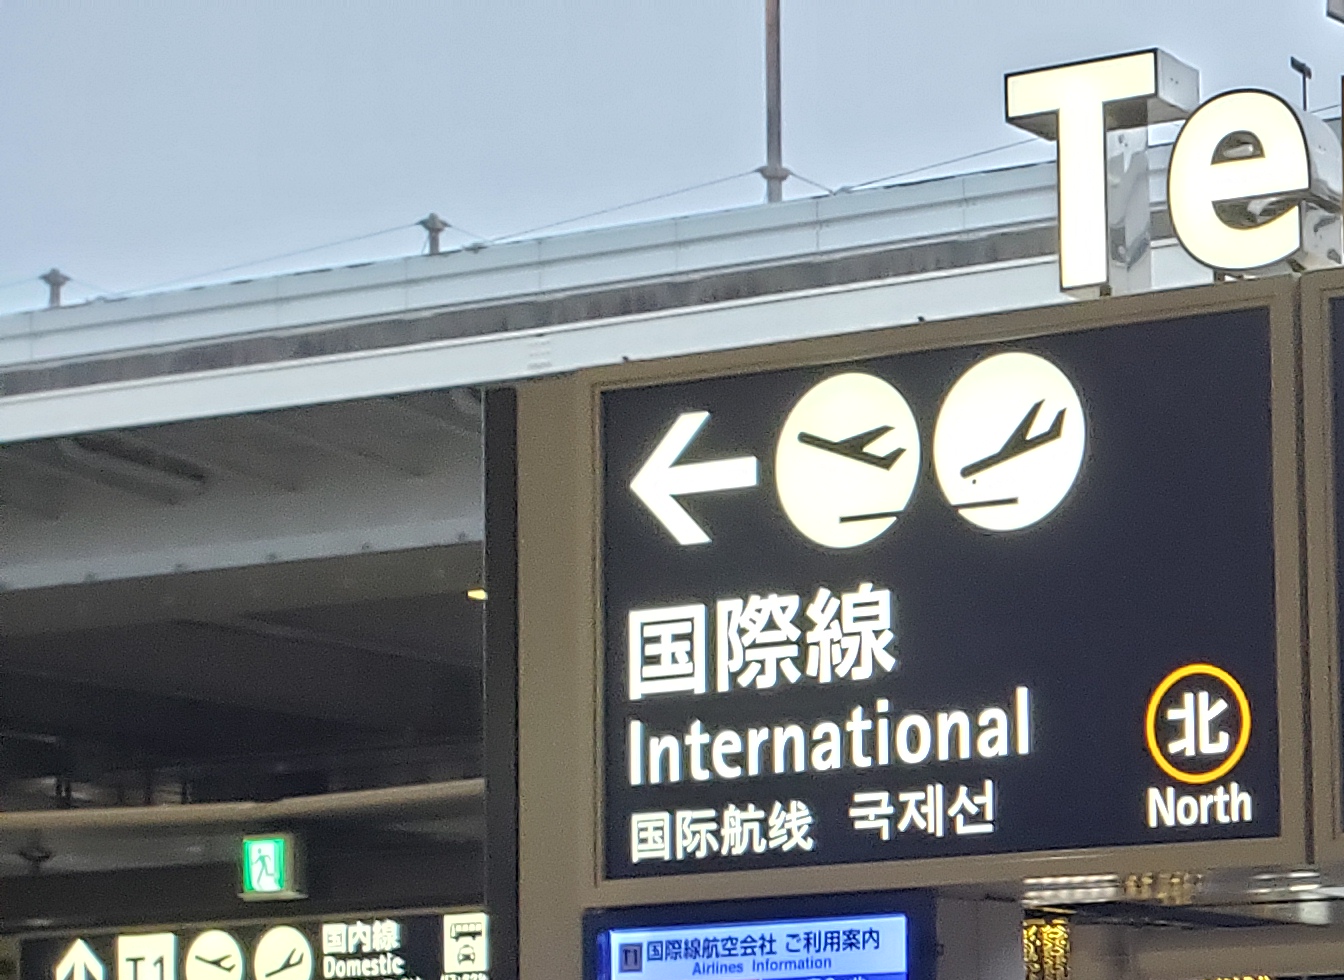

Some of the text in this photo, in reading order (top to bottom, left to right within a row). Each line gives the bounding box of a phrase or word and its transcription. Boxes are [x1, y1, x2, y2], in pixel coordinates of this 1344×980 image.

[627, 583, 898, 700] 国際線
[629, 685, 1033, 787] International
[1166, 690, 1231, 759] 北
[630, 779, 996, 864] 国际航线 국제선
[1147, 783, 1253, 829] North
[322, 919, 400, 953] 国内線
[647, 927, 881, 962] 国際線航空会社 ご利用案内
[323, 952, 405, 978] Domestic
[692, 955, 832, 976] Airlines Information
